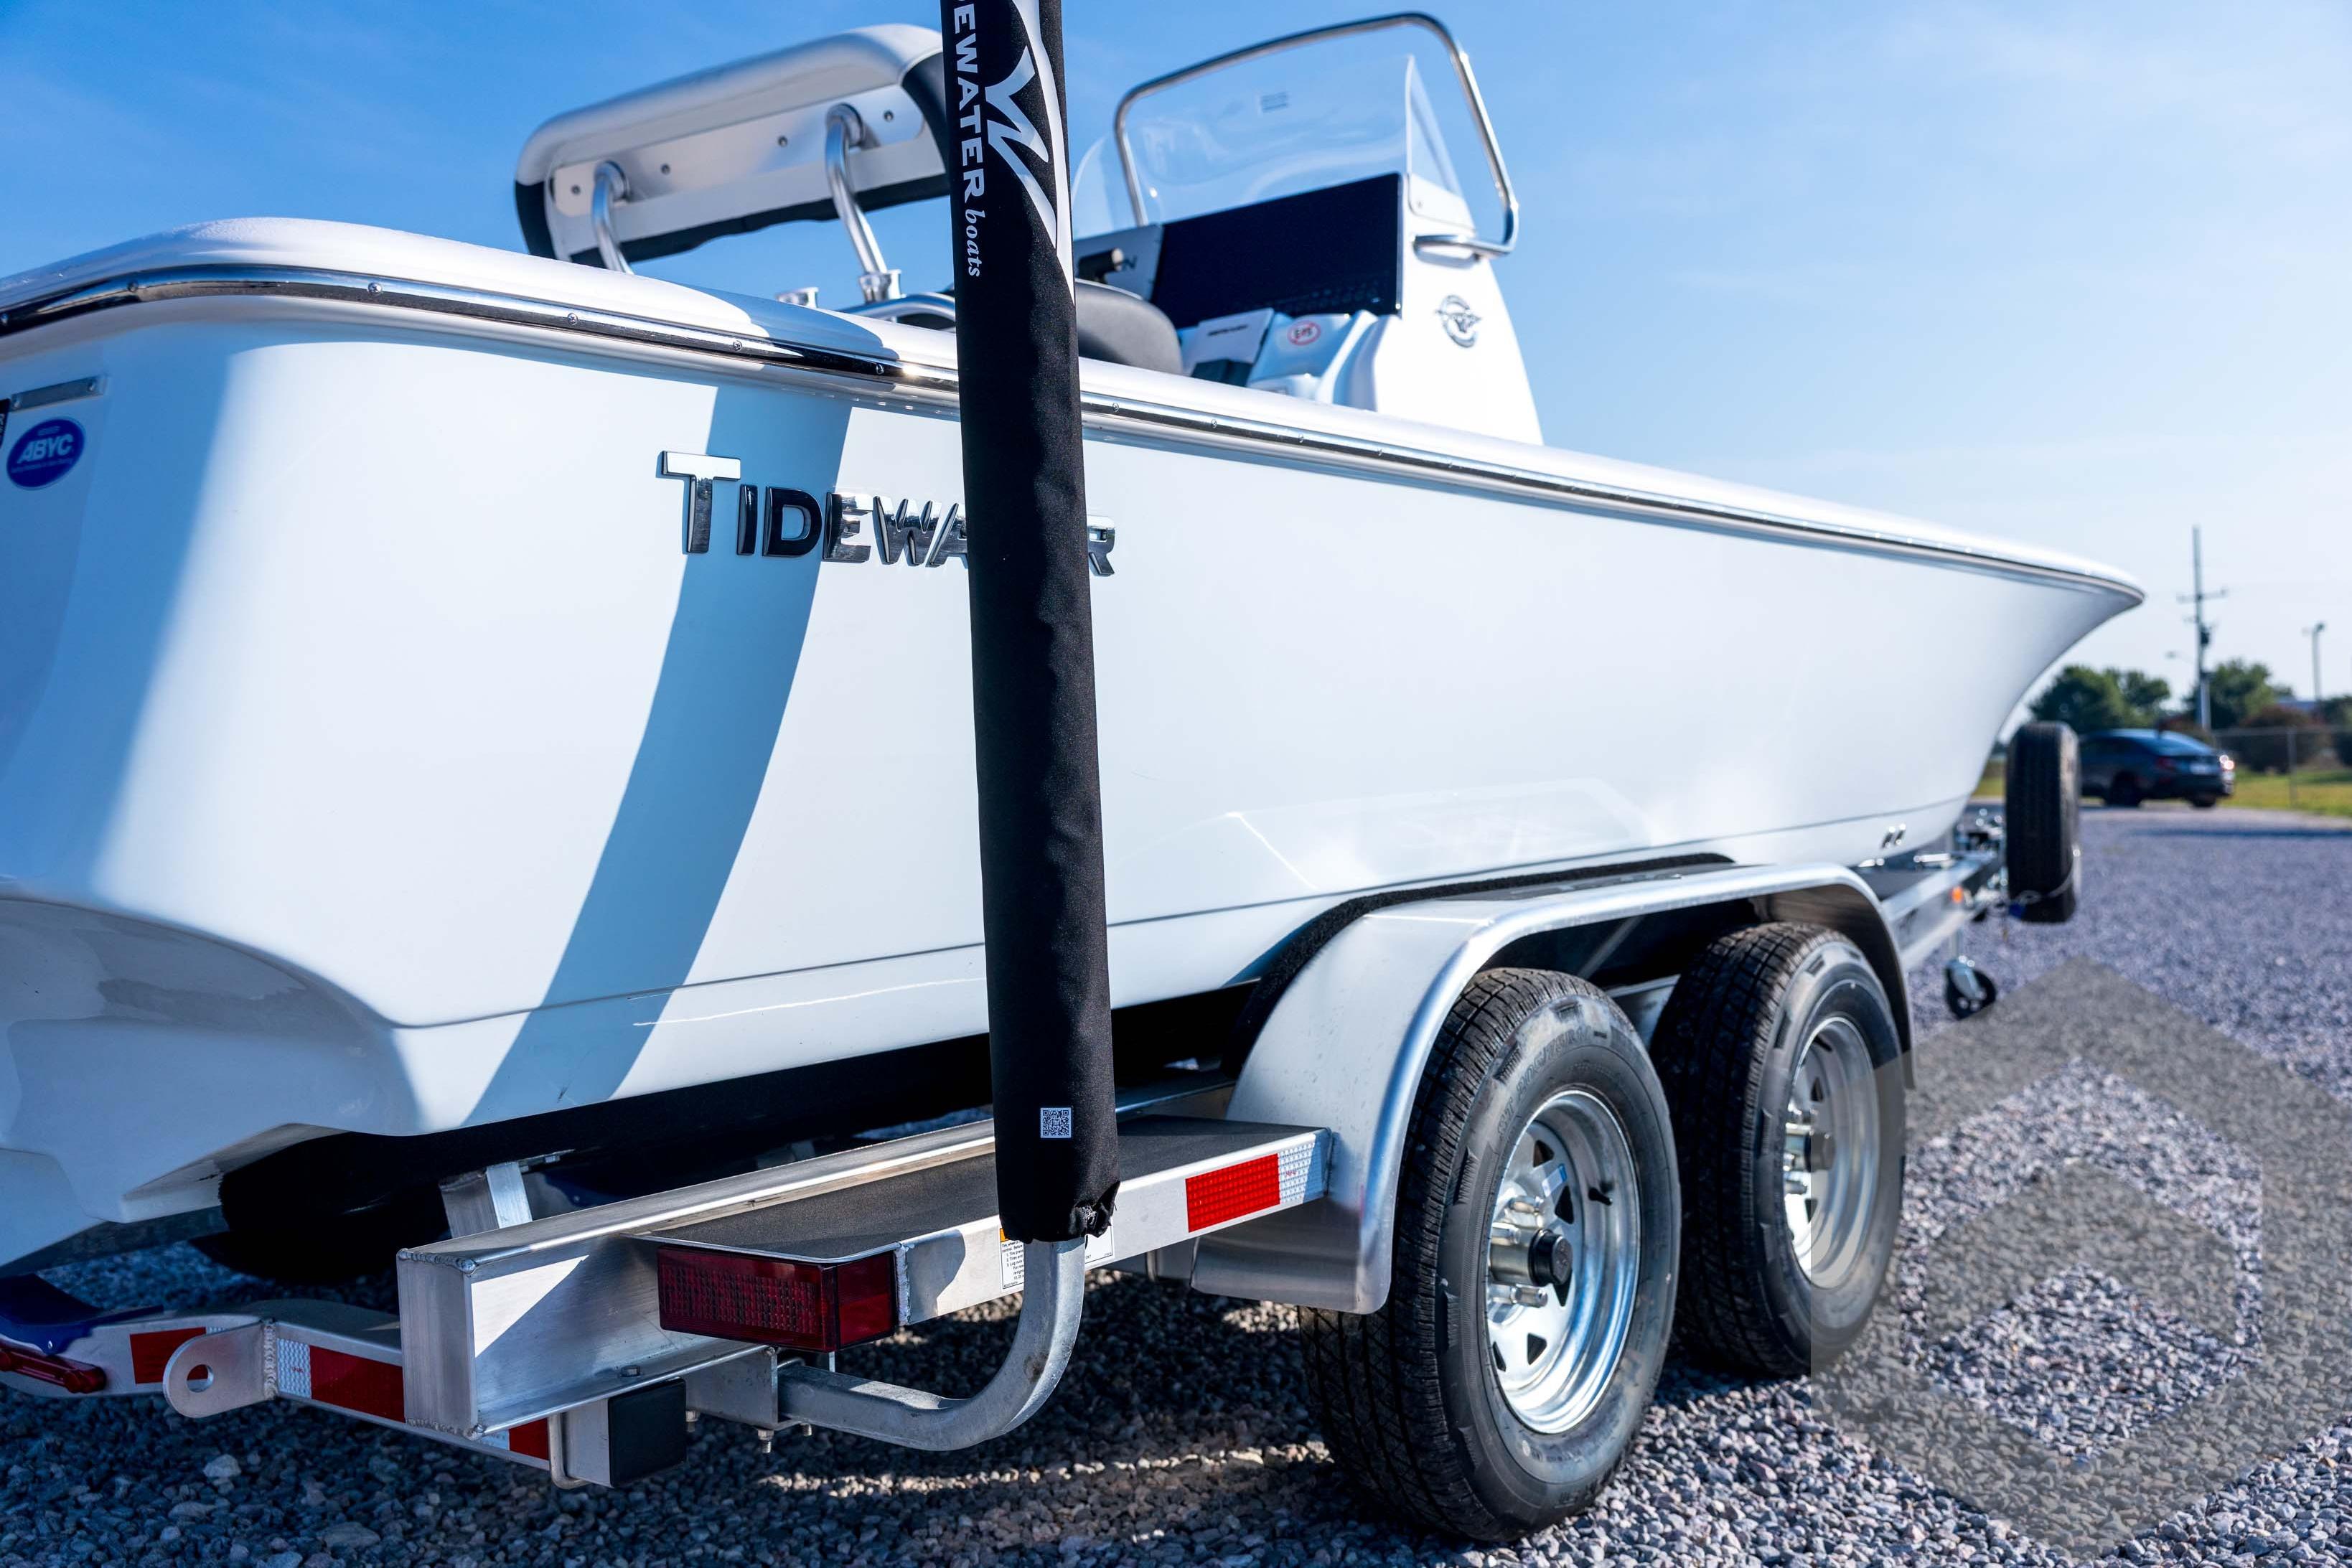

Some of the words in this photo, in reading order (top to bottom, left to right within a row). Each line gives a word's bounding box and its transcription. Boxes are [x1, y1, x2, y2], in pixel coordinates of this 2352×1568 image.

[954, 0, 985, 203] EWATER
[965, 208, 985, 277] boats
[17, 434, 74, 463] ABYC
[660, 450, 1115, 576] TIDEWAR
